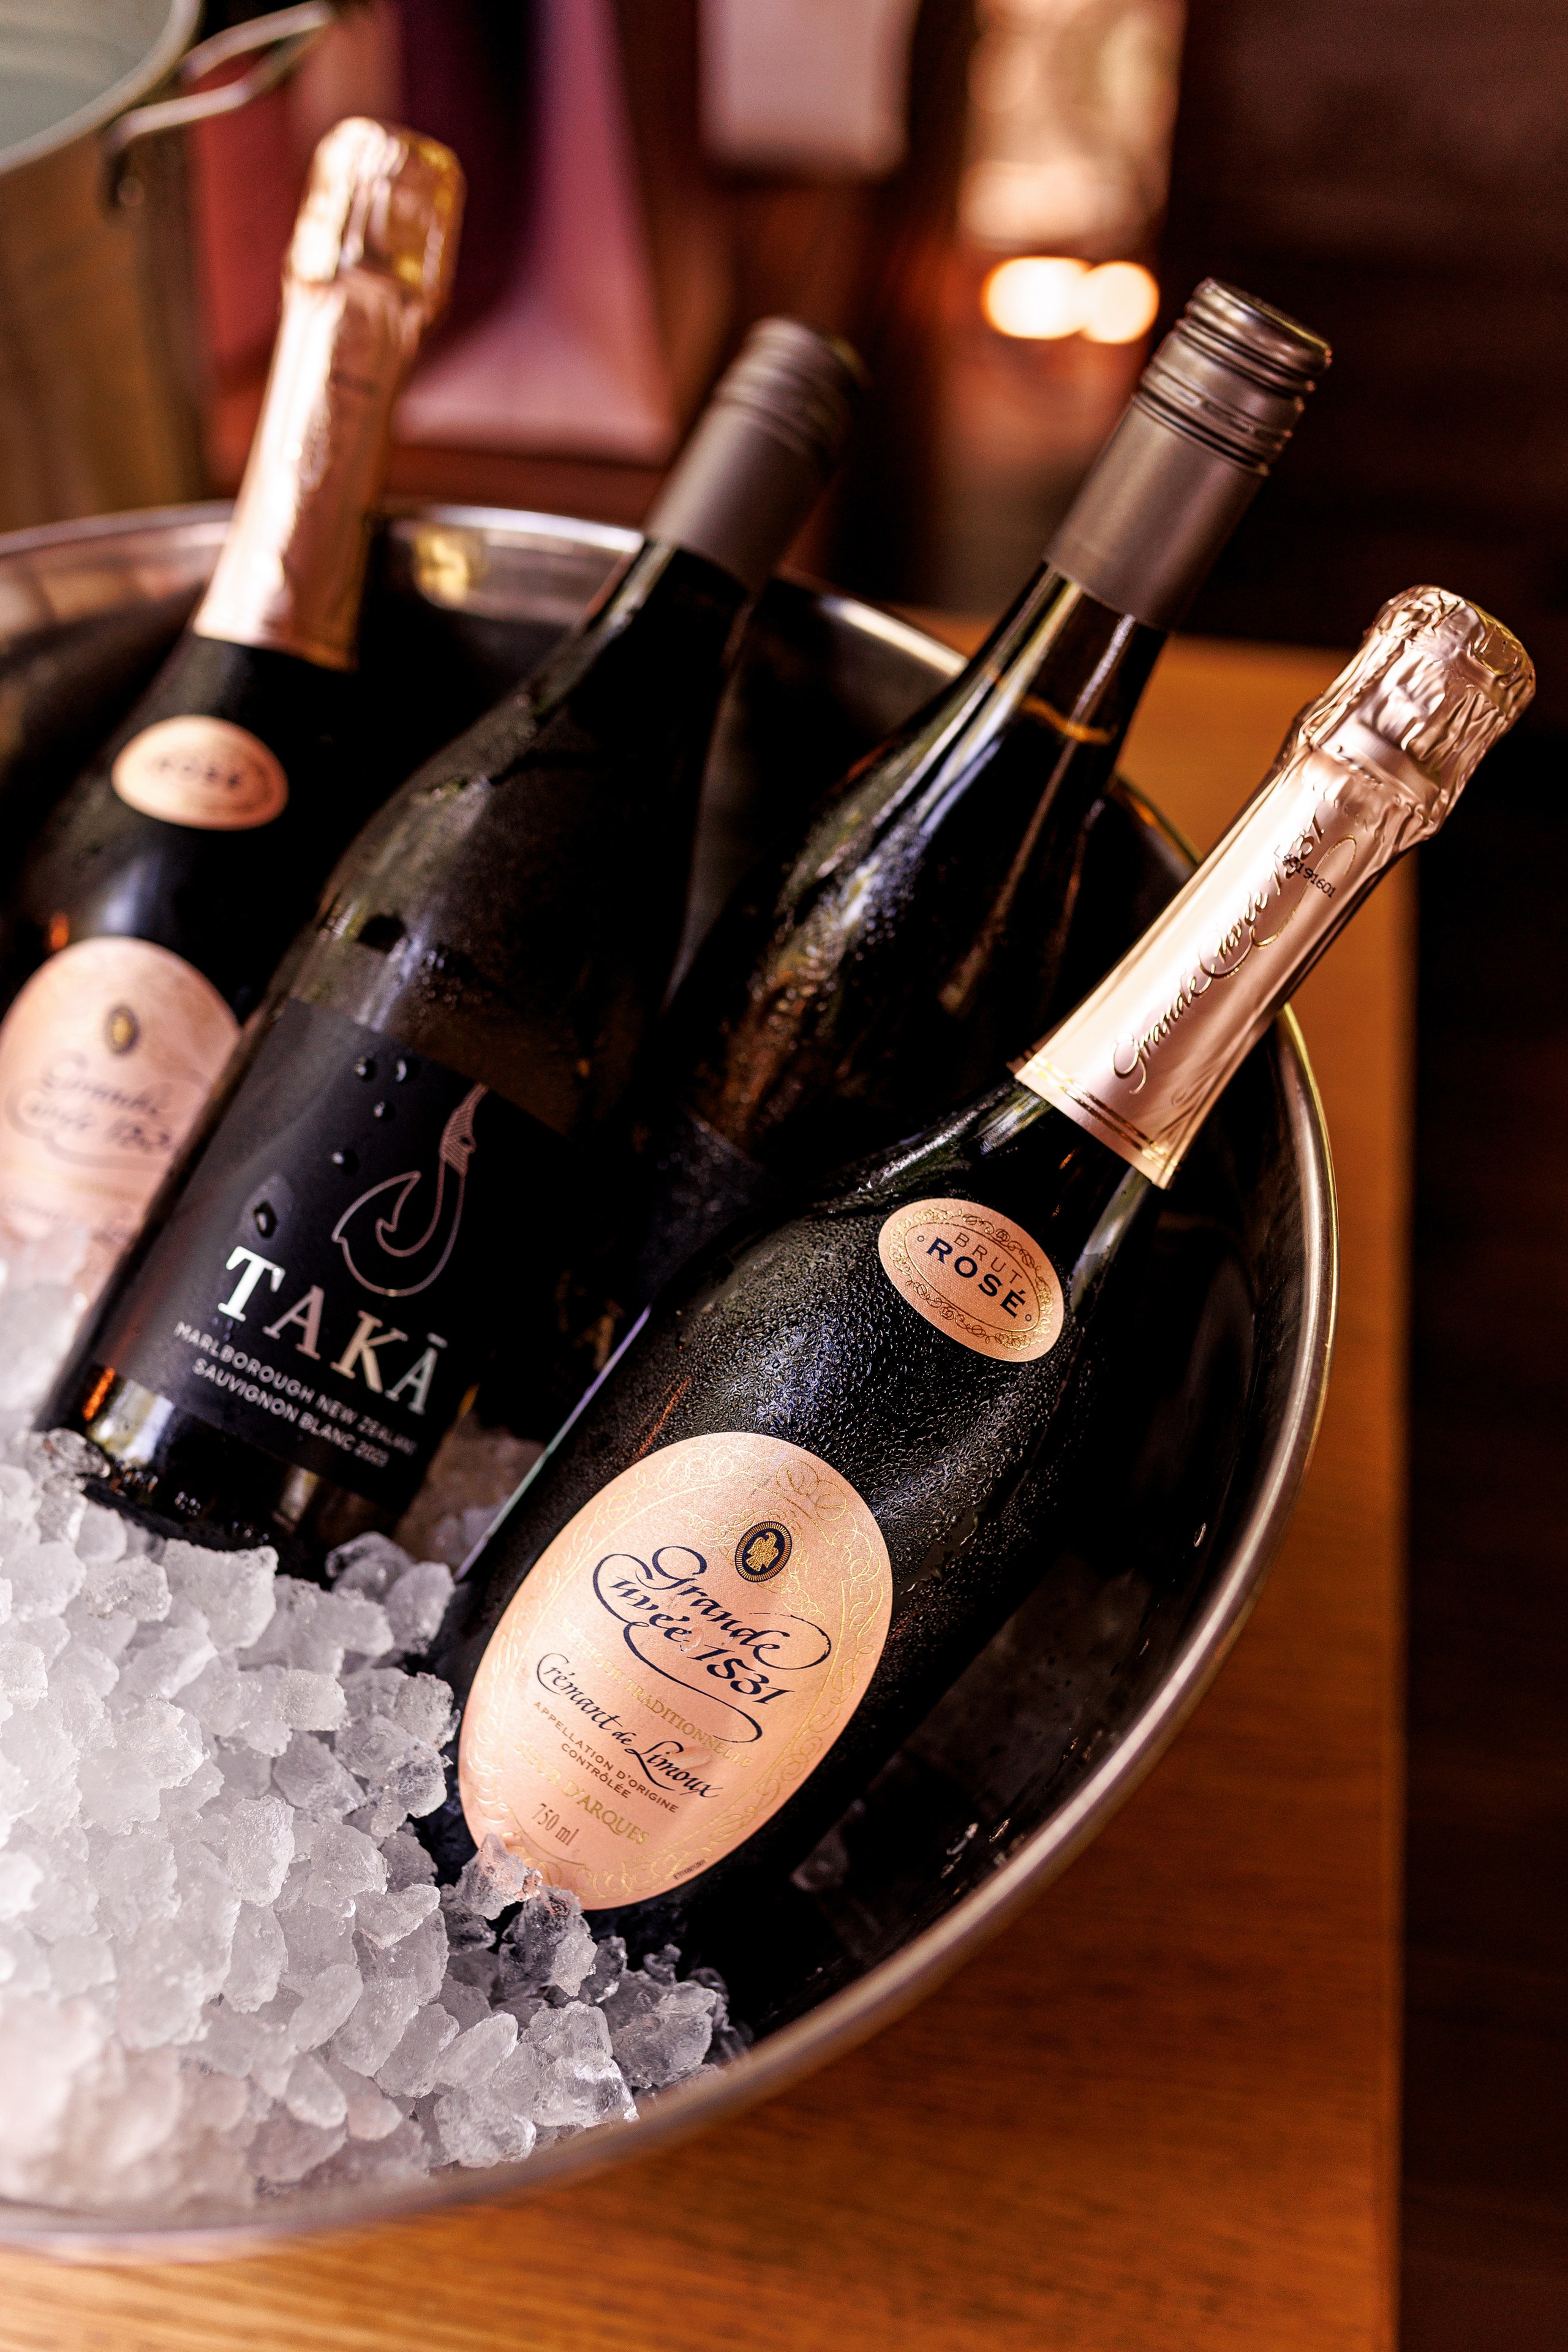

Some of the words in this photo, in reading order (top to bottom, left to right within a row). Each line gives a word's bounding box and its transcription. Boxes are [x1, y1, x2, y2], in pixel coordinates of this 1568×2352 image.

[1111, 967, 1212, 1095] Grande
[925, 1237, 1027, 1319] ROSÉ
[953, 1232, 1023, 1284] BRUT
[173, 1321, 315, 1404] MARLBOROUGH
[315, 1393, 358, 1425] NEW
[217, 1245, 448, 1415] TAKĀ
[192, 1358, 300, 1422] SAUVIGNON
[298, 1412, 356, 1451] BLANC
[593, 1553, 692, 1646] Cuvée
[687, 1644, 795, 1705] 1531
[635, 1545, 831, 1670] Grande
[533, 1701, 614, 1771] APPELLATION
[616, 1770, 679, 1813] D'ORIGINE
[537, 1653, 624, 1731] Crémant
[612, 1731, 636, 1746] de
[624, 1740, 725, 1798] Limoux
[561, 1743, 631, 1799] CONTRÔLÉE
[625, 1678, 755, 1770] TRADITIONNELLE
[515, 1739, 561, 1788] SIEUR
[562, 1779, 650, 1845] D'ARQUES
[532, 1802, 560, 1831] 750
[555, 1825, 580, 1846] ml
